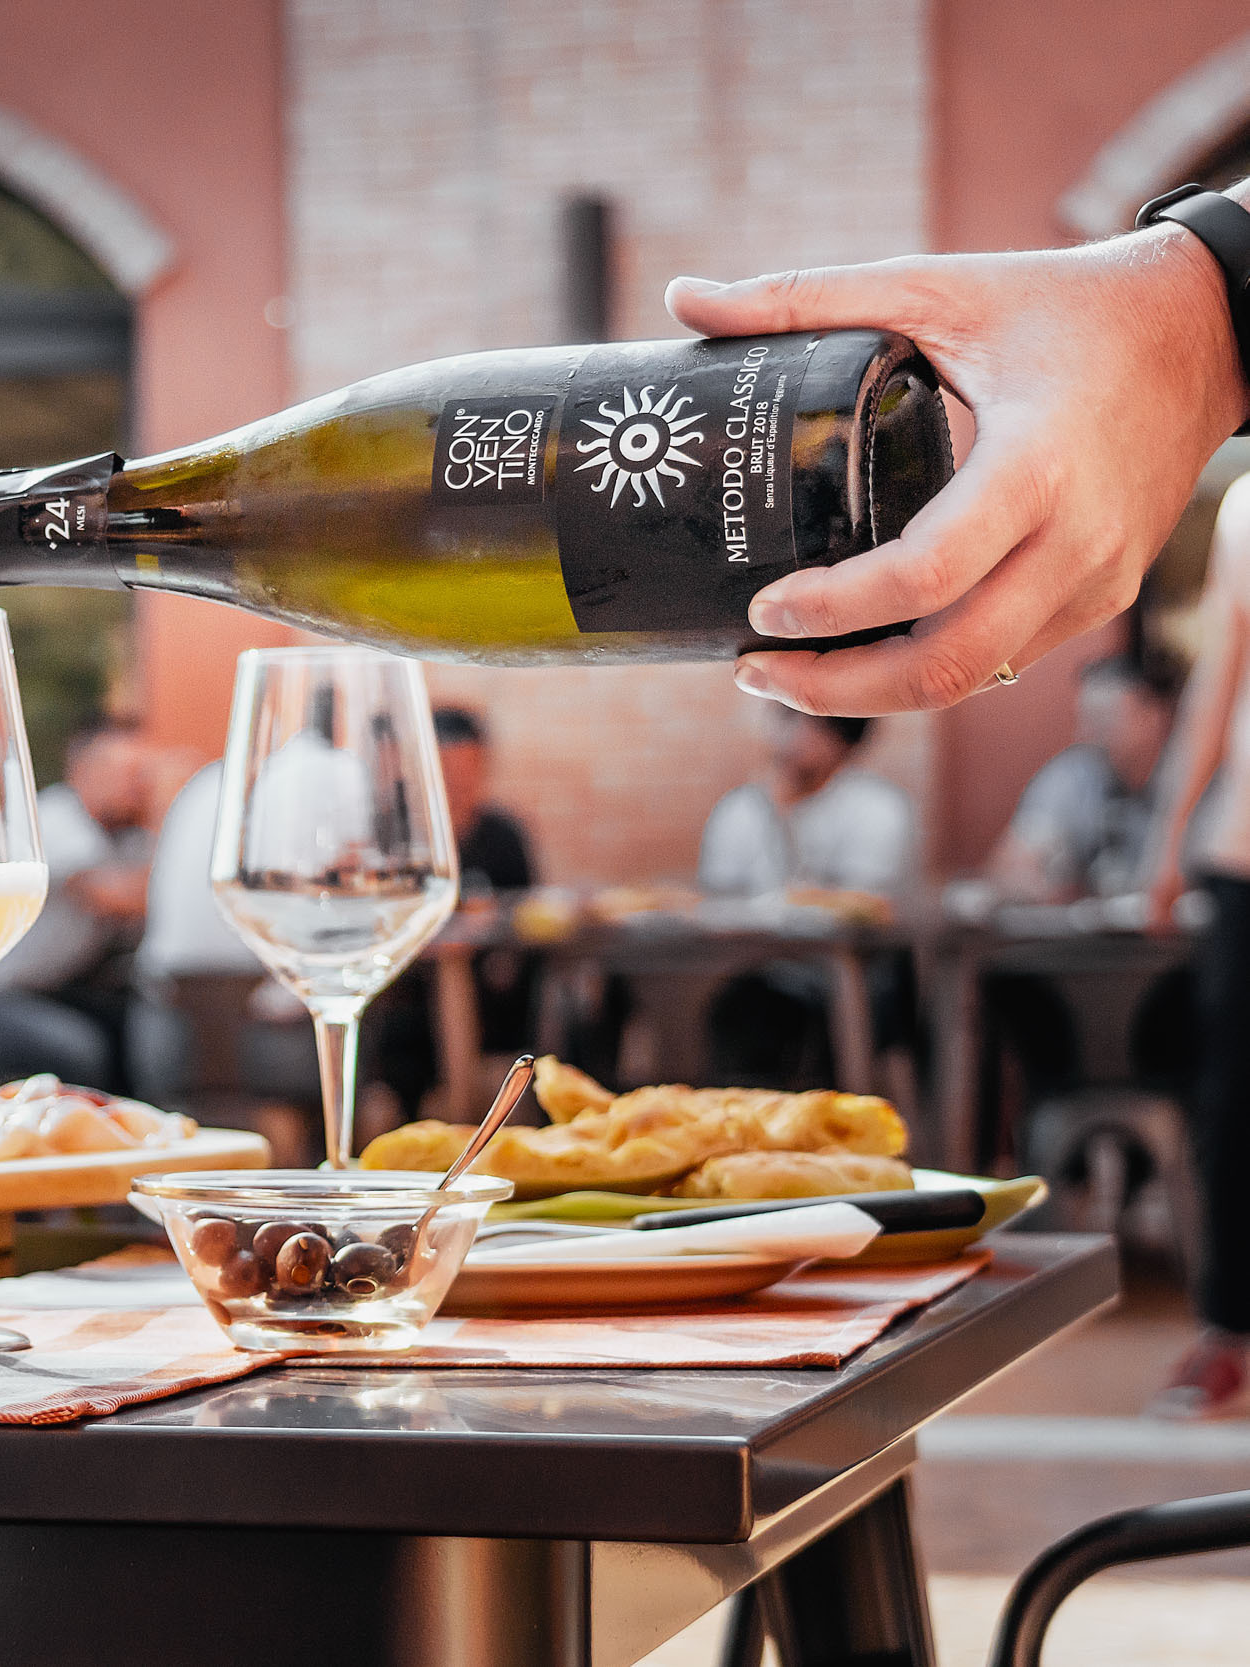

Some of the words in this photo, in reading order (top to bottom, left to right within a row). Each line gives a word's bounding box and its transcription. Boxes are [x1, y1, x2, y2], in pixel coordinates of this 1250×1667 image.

[726, 347, 769, 440] CLASSICO
[753, 401, 769, 434] 2018
[473, 418, 504, 488] VEN
[497, 409, 532, 490] TINO
[527, 410, 545, 486] MONTECICCARDO
[750, 438, 764, 474] BRUT
[765, 451, 775, 482] Liqueur
[76, 505, 86, 531] MESI
[723, 447, 749, 563] METODO
[765, 483, 774, 509] Senza
